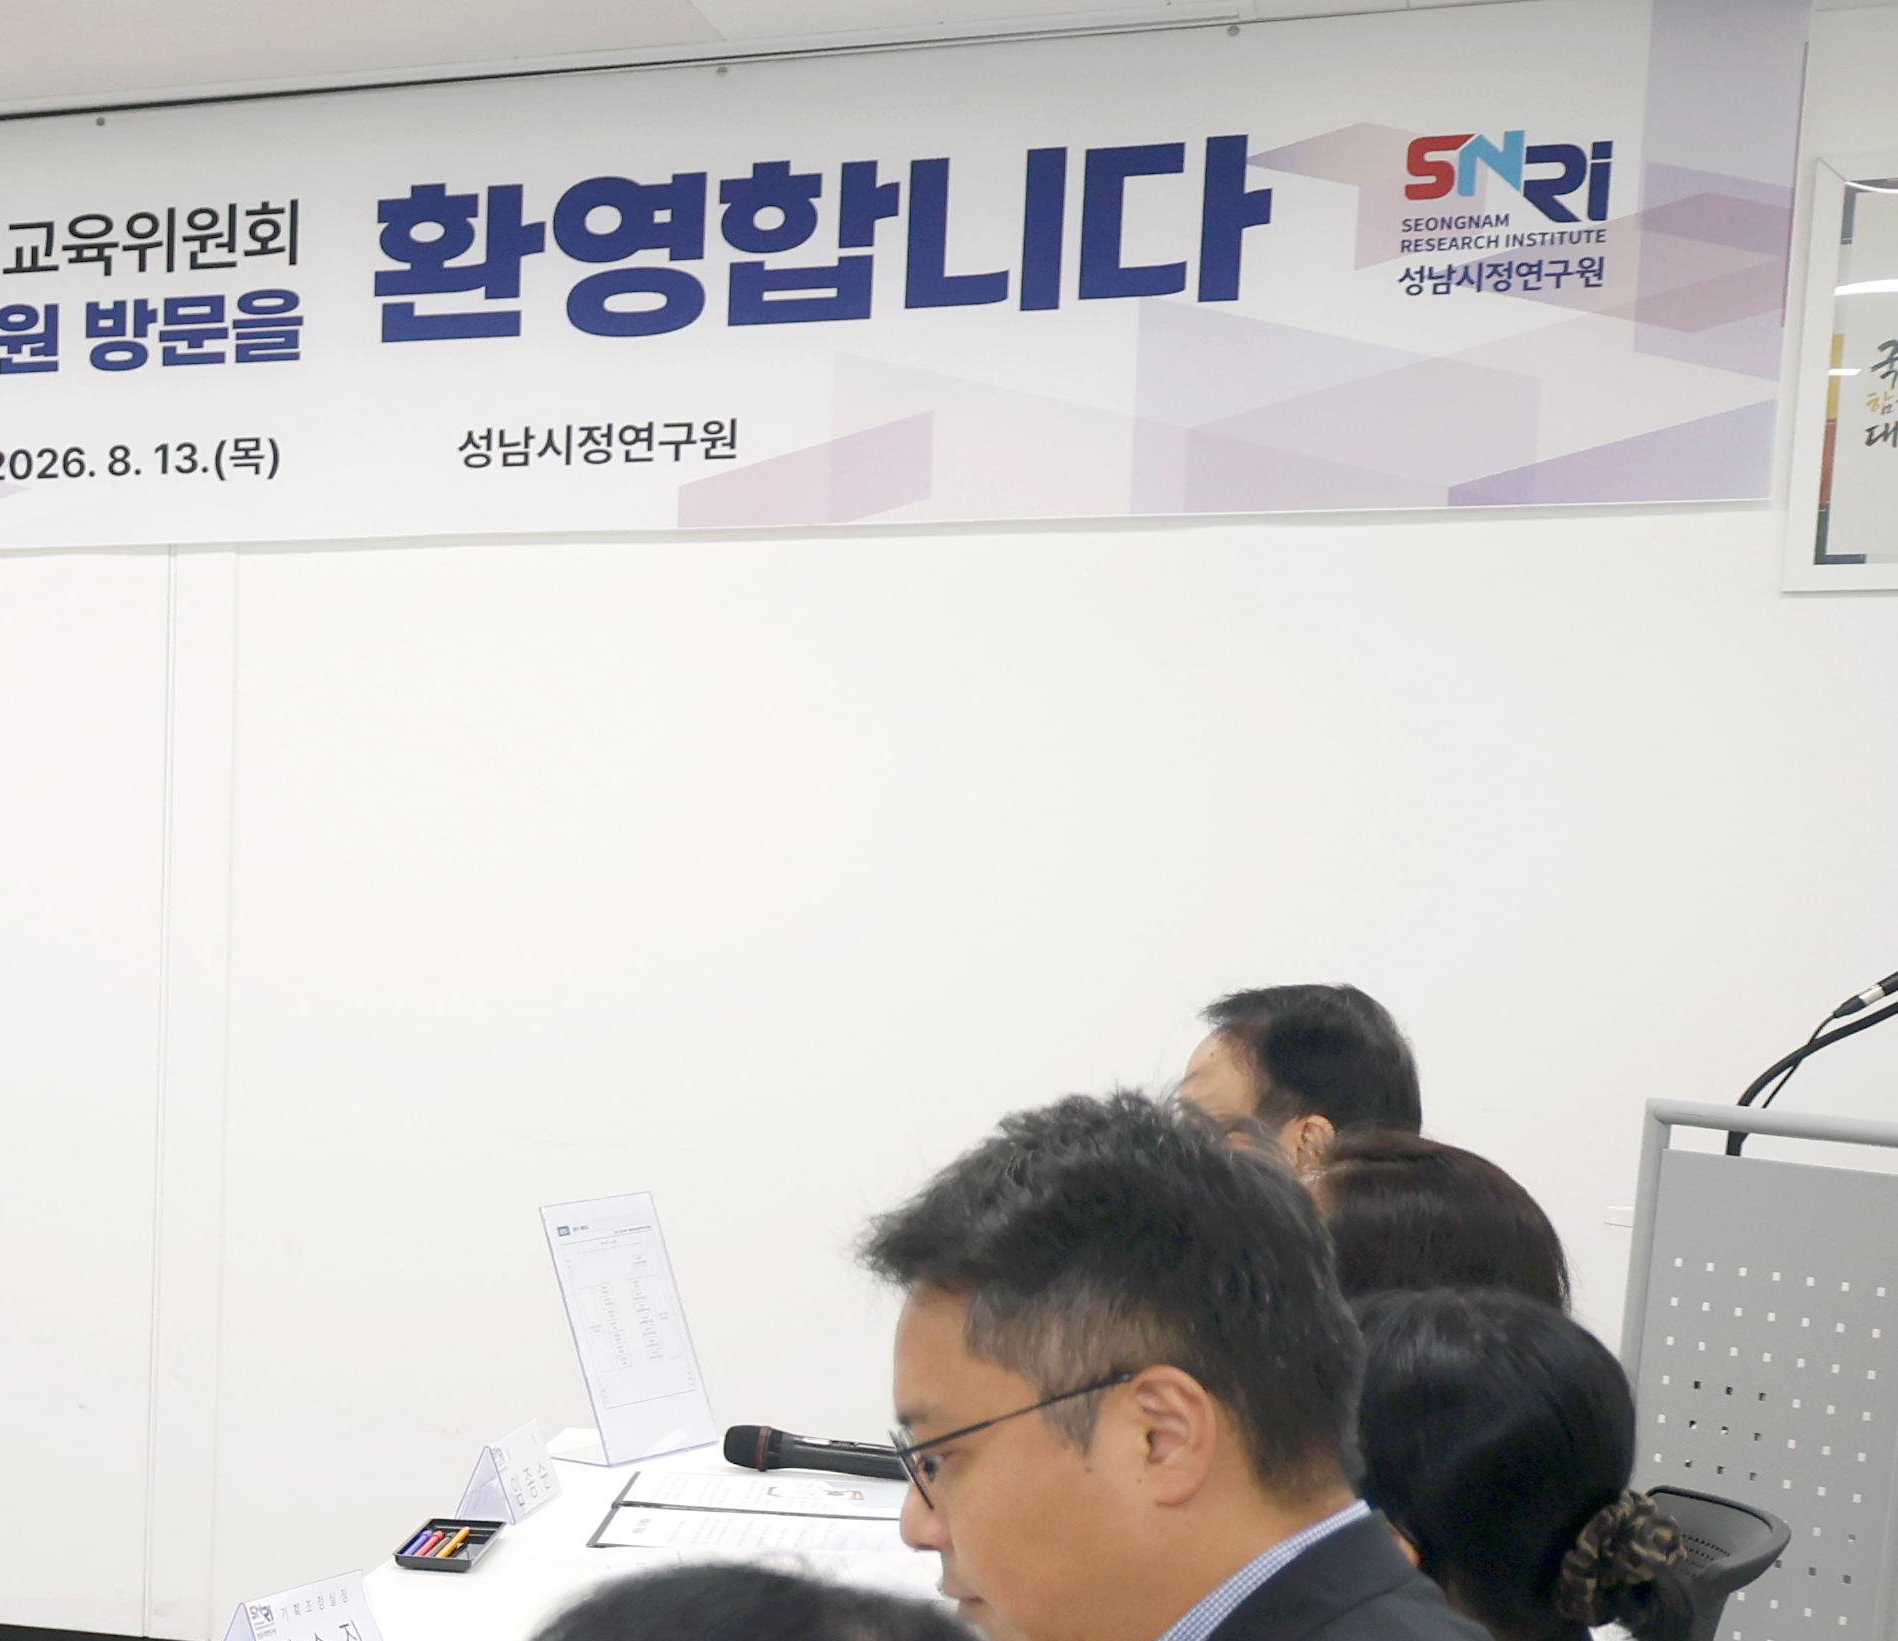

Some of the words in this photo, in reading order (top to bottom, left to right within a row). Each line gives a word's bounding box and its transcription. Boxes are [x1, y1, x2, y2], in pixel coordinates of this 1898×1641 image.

[374, 133, 1273, 343] 환영합니다
[1401, 213, 1510, 233] SEONGNAM
[1401, 233, 1499, 253] RESEARCH
[1505, 229, 1608, 248] INSTITUTE
[1398, 256, 1604, 296] 성남시정연구원
[85, 288, 304, 372] 방문을
[107, 445, 141, 477] 8.
[154, 436, 281, 480] 13.(목)
[457, 416, 739, 469] 성남시정연구원
